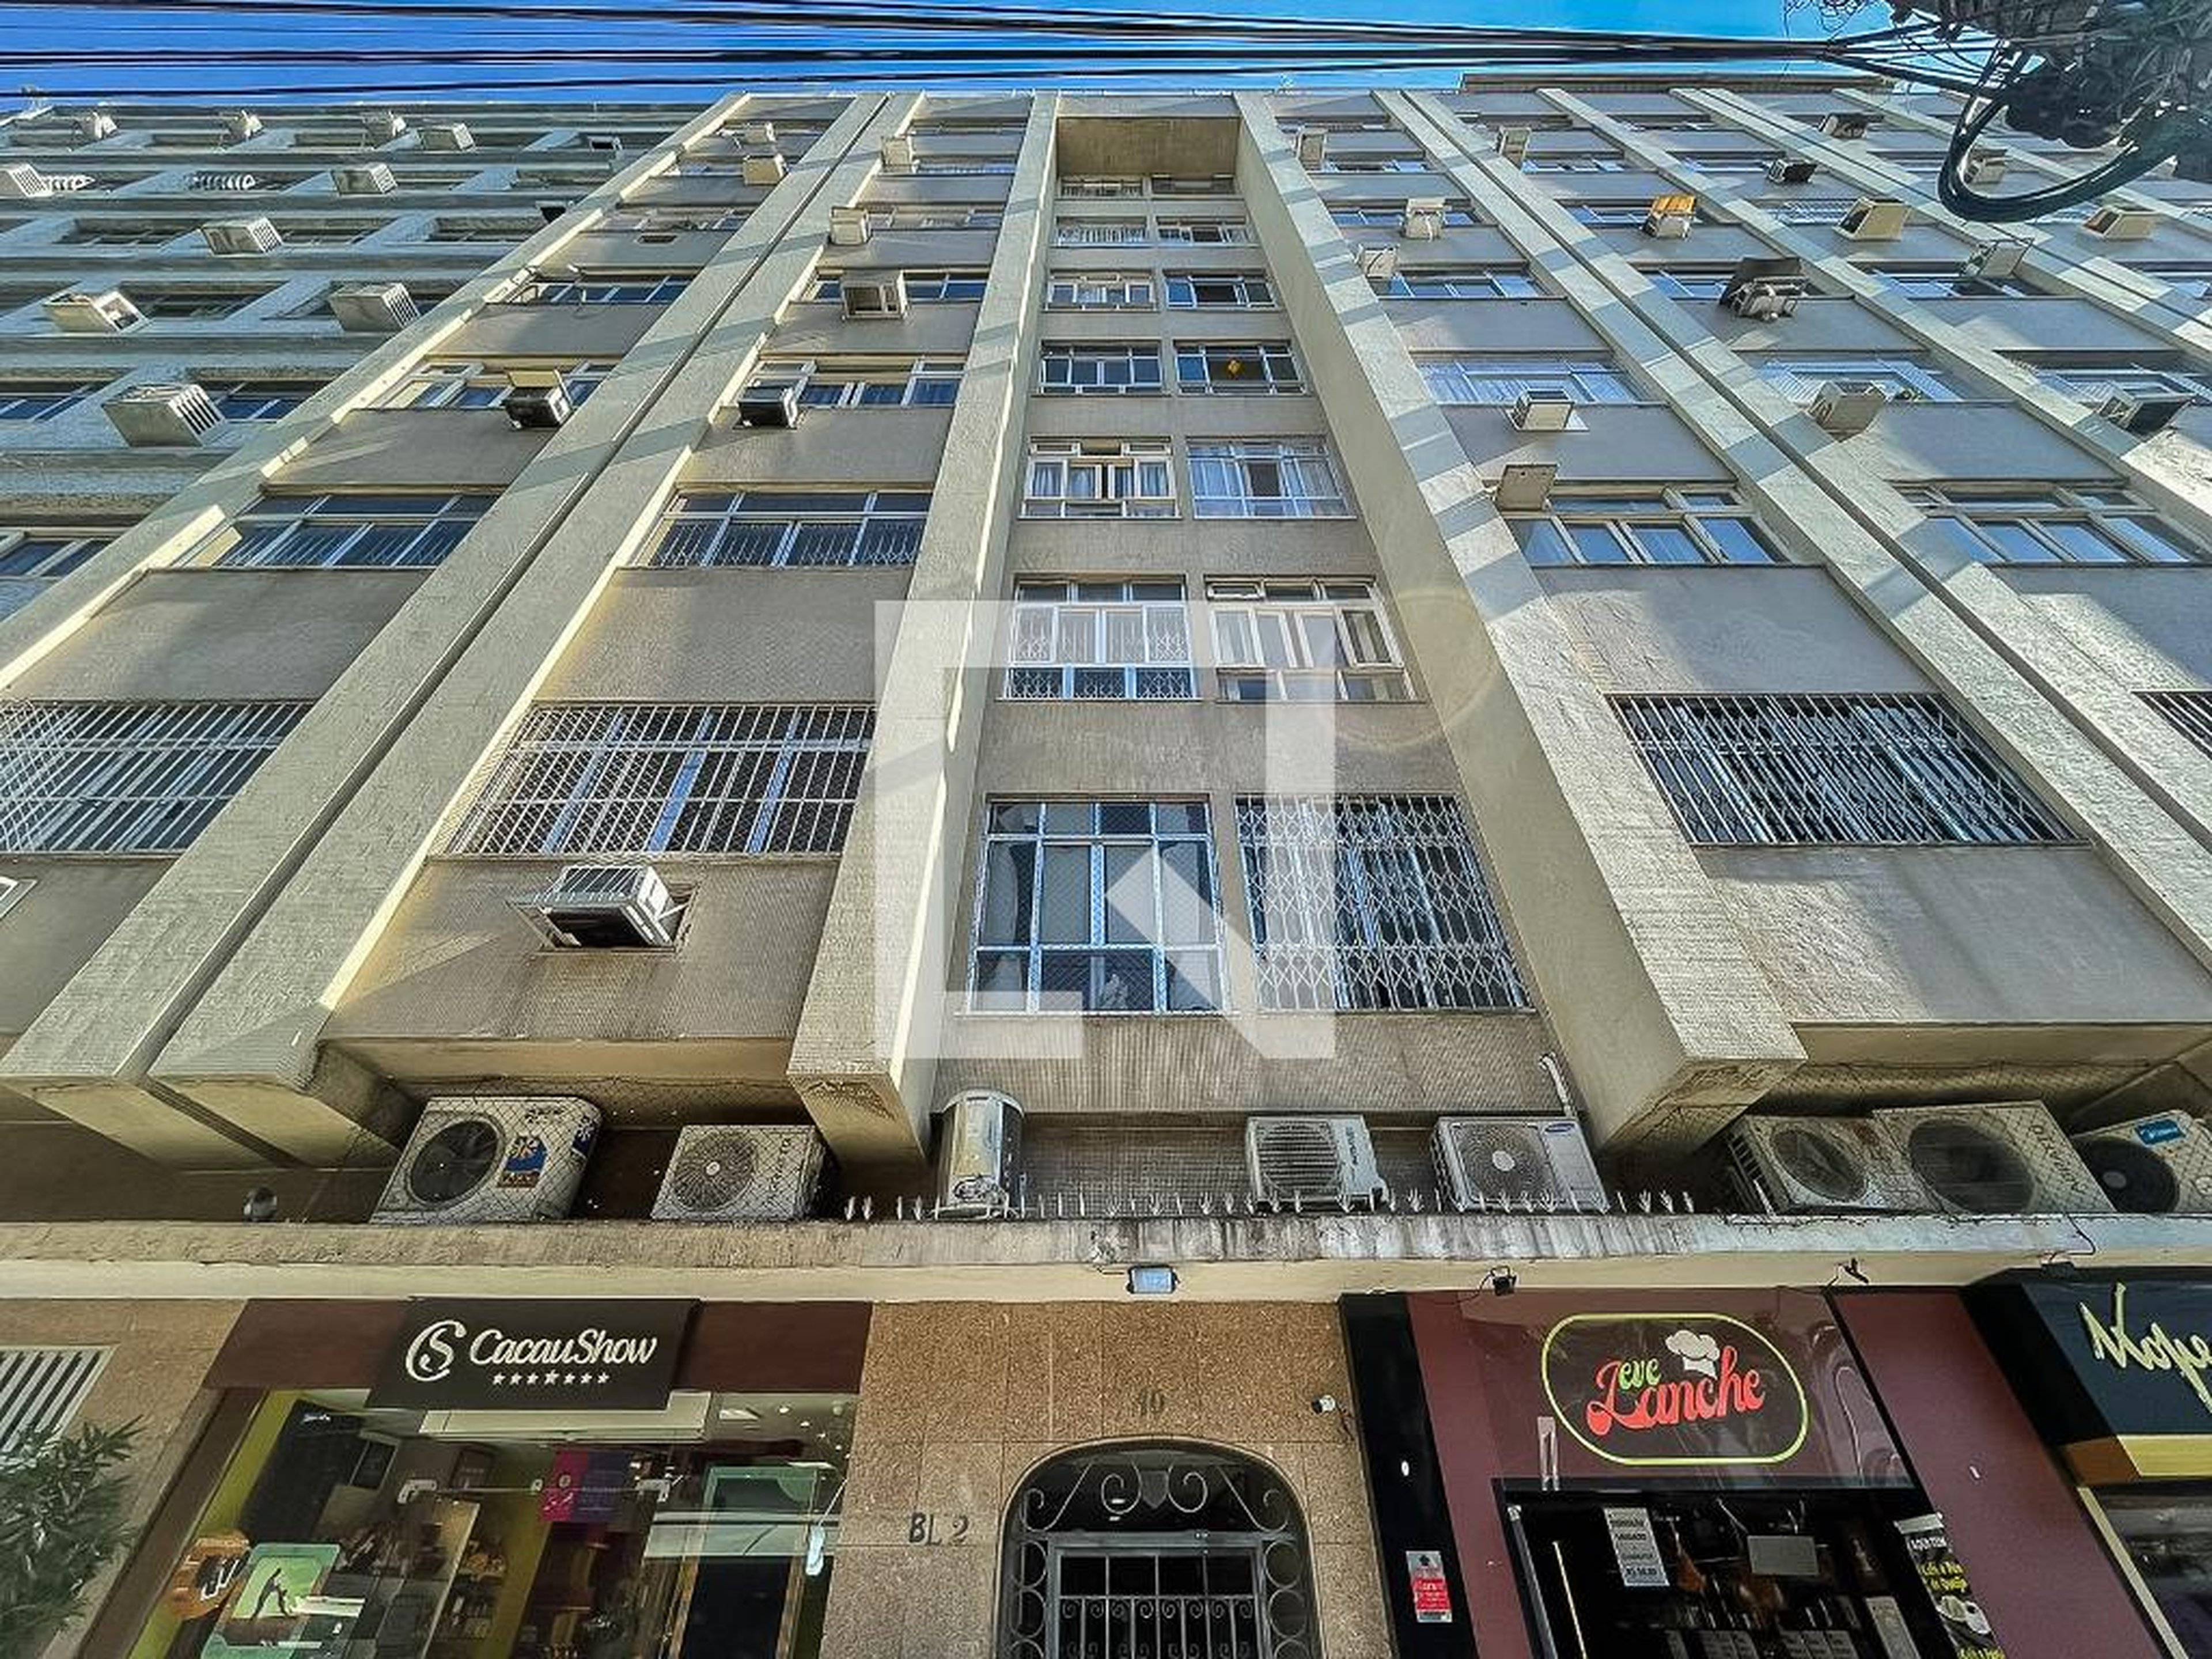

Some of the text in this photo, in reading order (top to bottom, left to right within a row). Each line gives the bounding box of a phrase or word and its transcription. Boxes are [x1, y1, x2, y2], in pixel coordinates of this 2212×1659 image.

[1587, 1345, 1766, 1436] Lanche
[909, 1512, 969, 1546] BL 2
